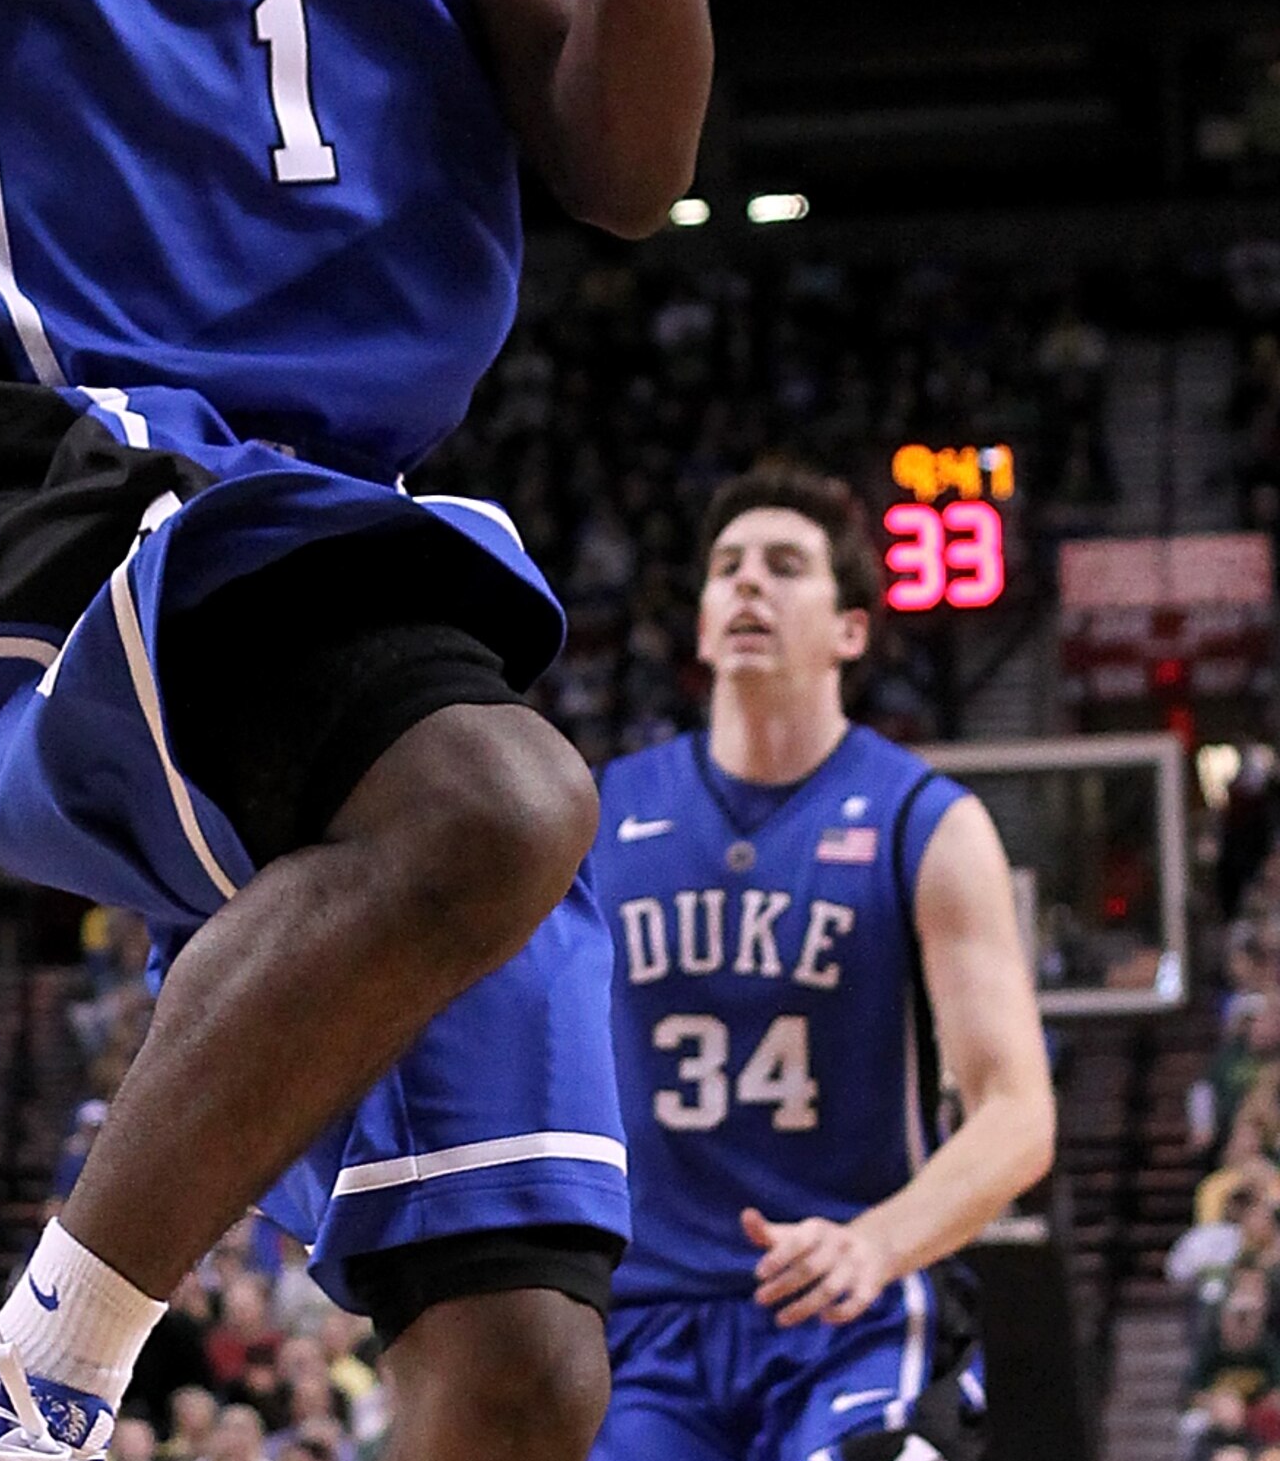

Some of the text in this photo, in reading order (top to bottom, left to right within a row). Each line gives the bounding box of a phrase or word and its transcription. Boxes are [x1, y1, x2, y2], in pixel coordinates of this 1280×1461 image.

[884, 501, 1004, 612] 33
[620, 889, 856, 989] DUKE
[654, 1014, 818, 1131] 34
